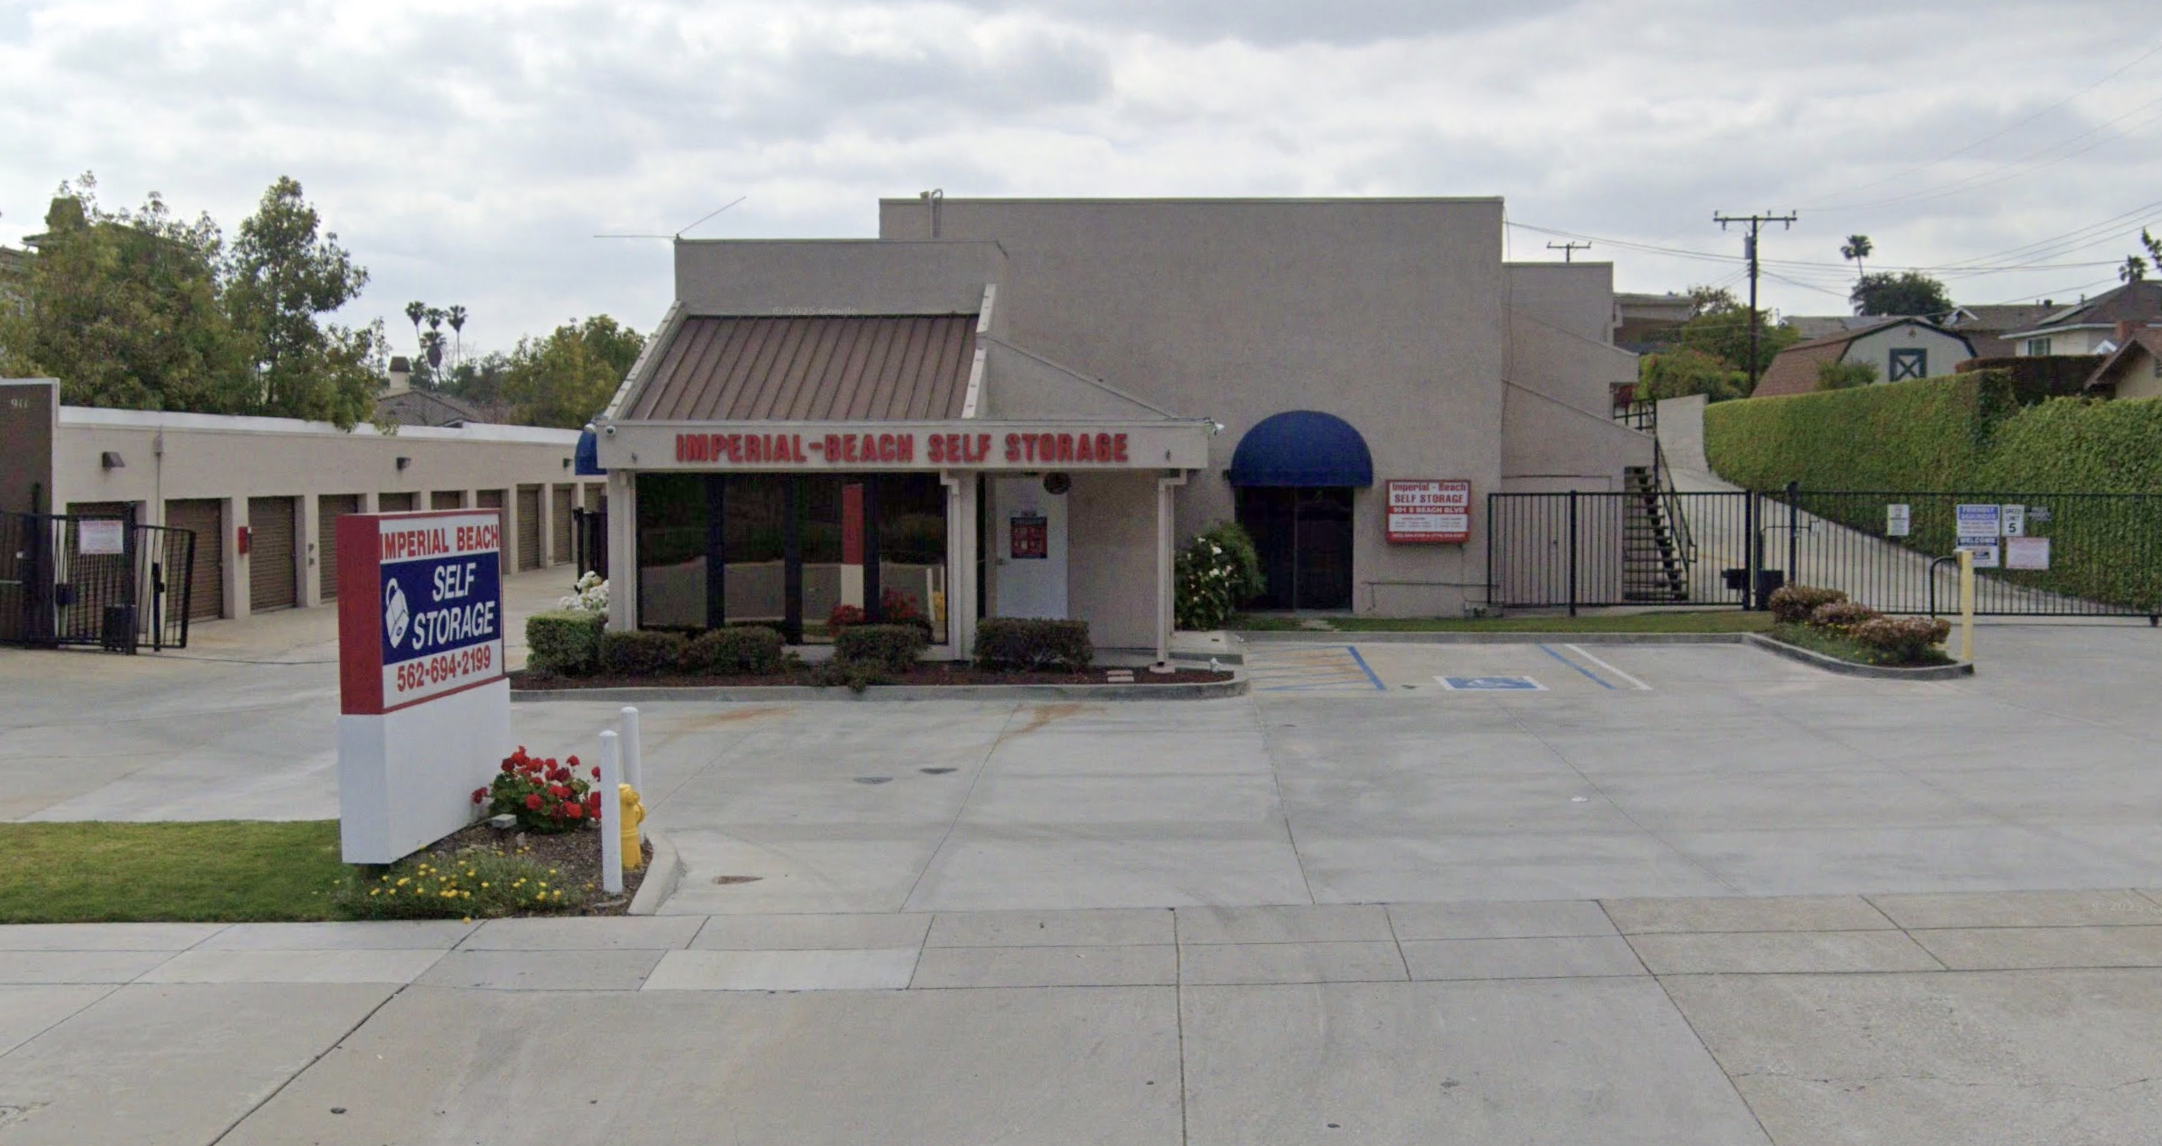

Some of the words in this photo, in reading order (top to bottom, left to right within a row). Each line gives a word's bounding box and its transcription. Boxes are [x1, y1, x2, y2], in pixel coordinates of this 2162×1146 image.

[928, 433, 992, 463] SELF
[1005, 433, 1129, 463] STORAGE
[1392, 482, 1429, 492] Imperial
[1438, 482, 1466, 491] Beach
[1394, 494, 1416, 503] SELF
[1420, 494, 1463, 503] STORAGE
[381, 528, 449, 559] IMPERIAL
[457, 524, 499, 551] BEACH
[2008, 522, 2016, 533] 5
[432, 562, 476, 602] SELF
[412, 600, 495, 650] STORAGE
[397, 645, 491, 691] 562-694-2199
